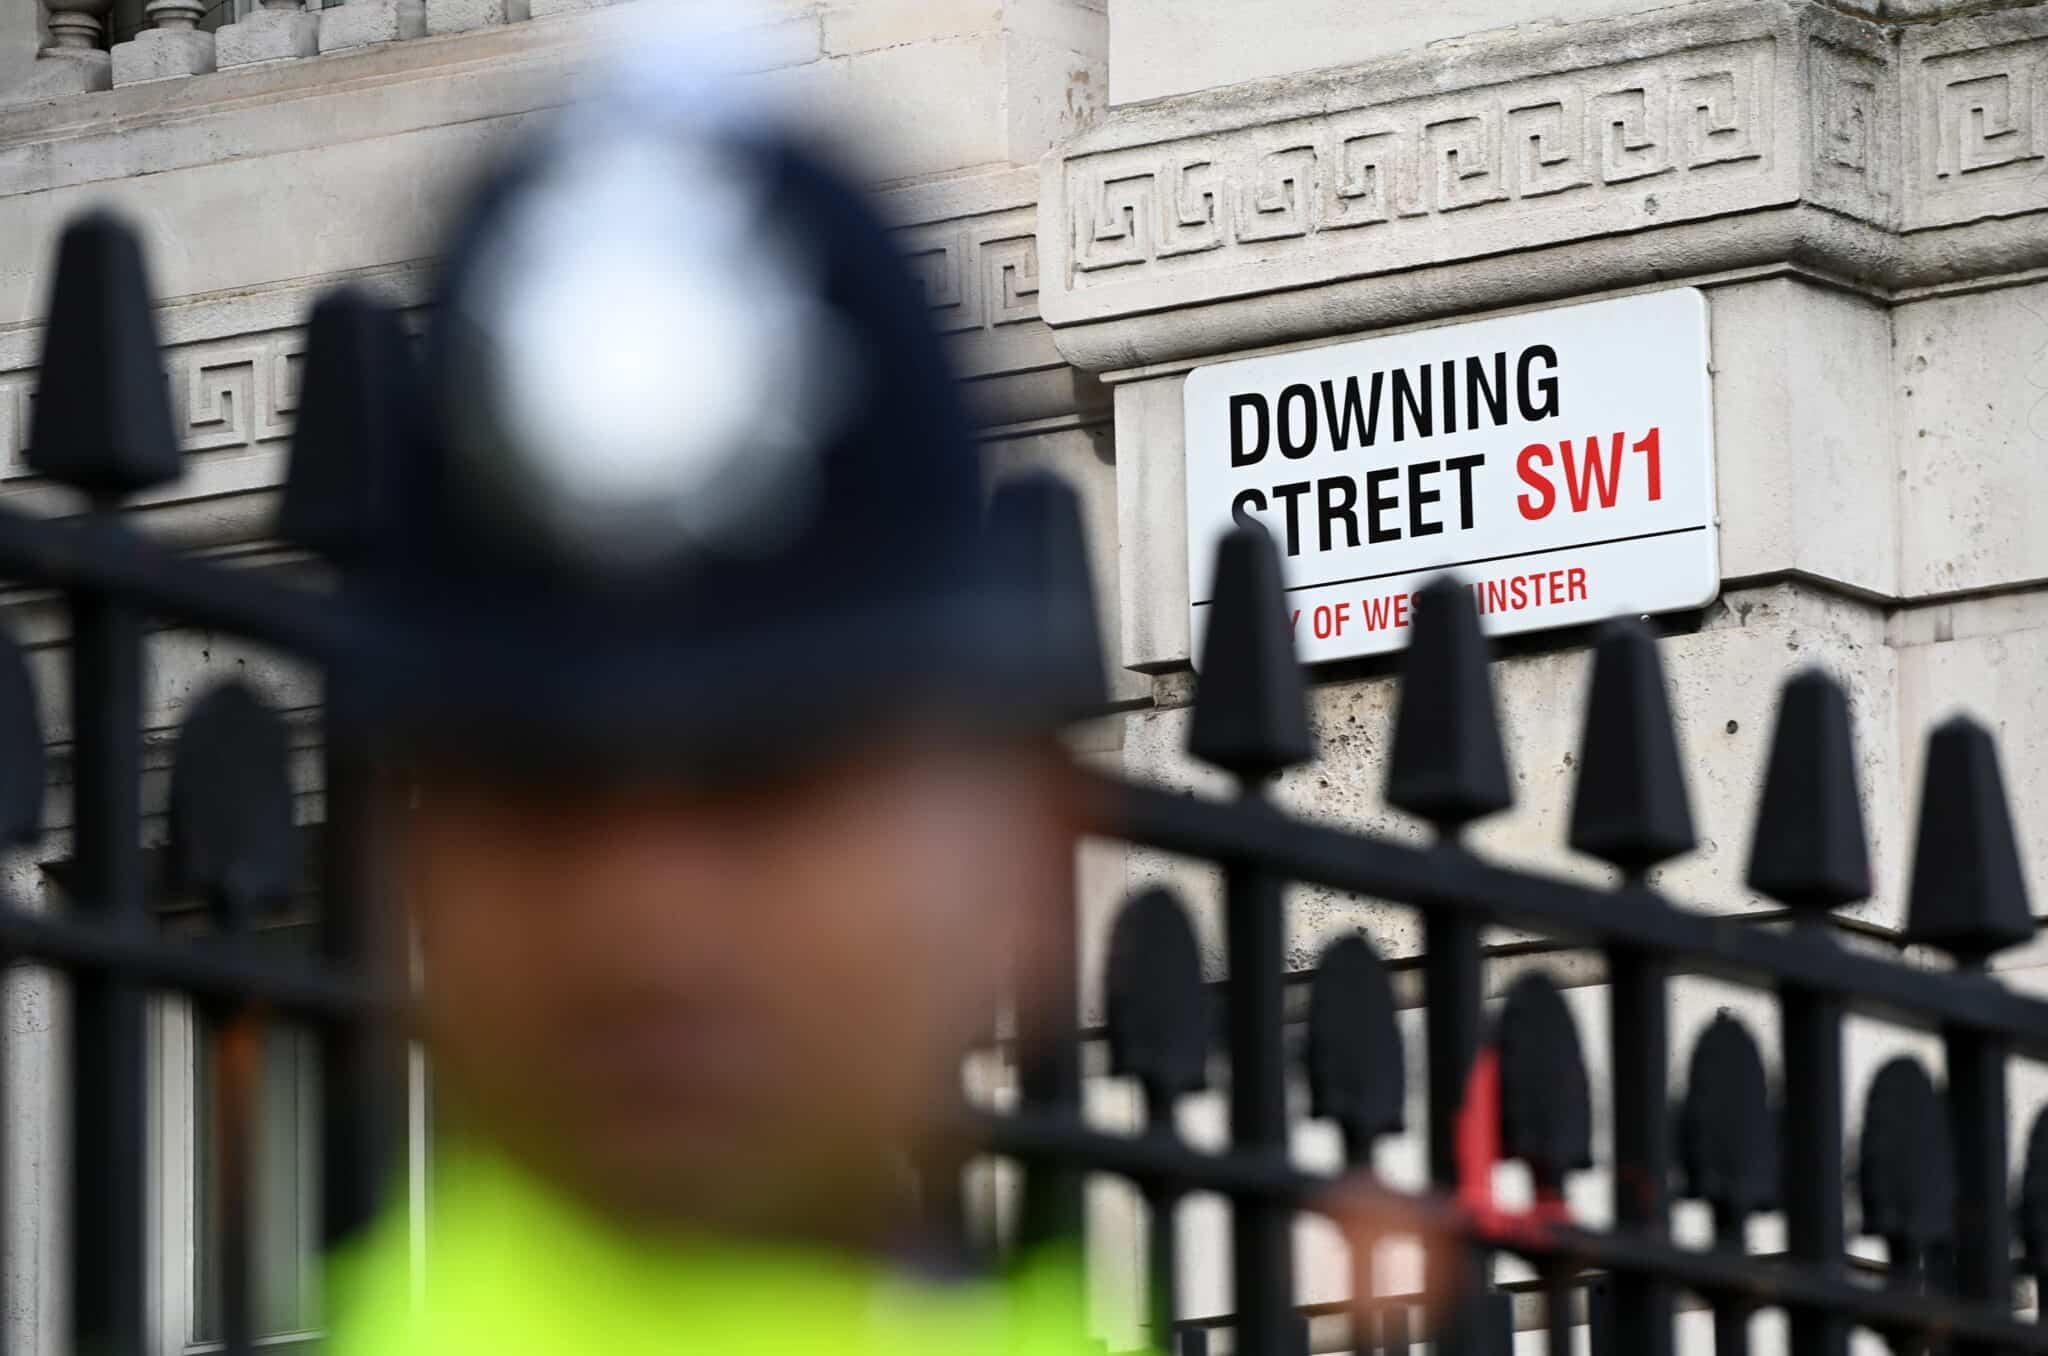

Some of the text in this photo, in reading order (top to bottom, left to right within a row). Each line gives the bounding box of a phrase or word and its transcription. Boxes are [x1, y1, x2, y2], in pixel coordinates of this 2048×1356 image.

[1229, 344, 1560, 468] DOWNING
[1231, 426, 1663, 558] STREET SW1
[1313, 603, 1350, 639] OF
